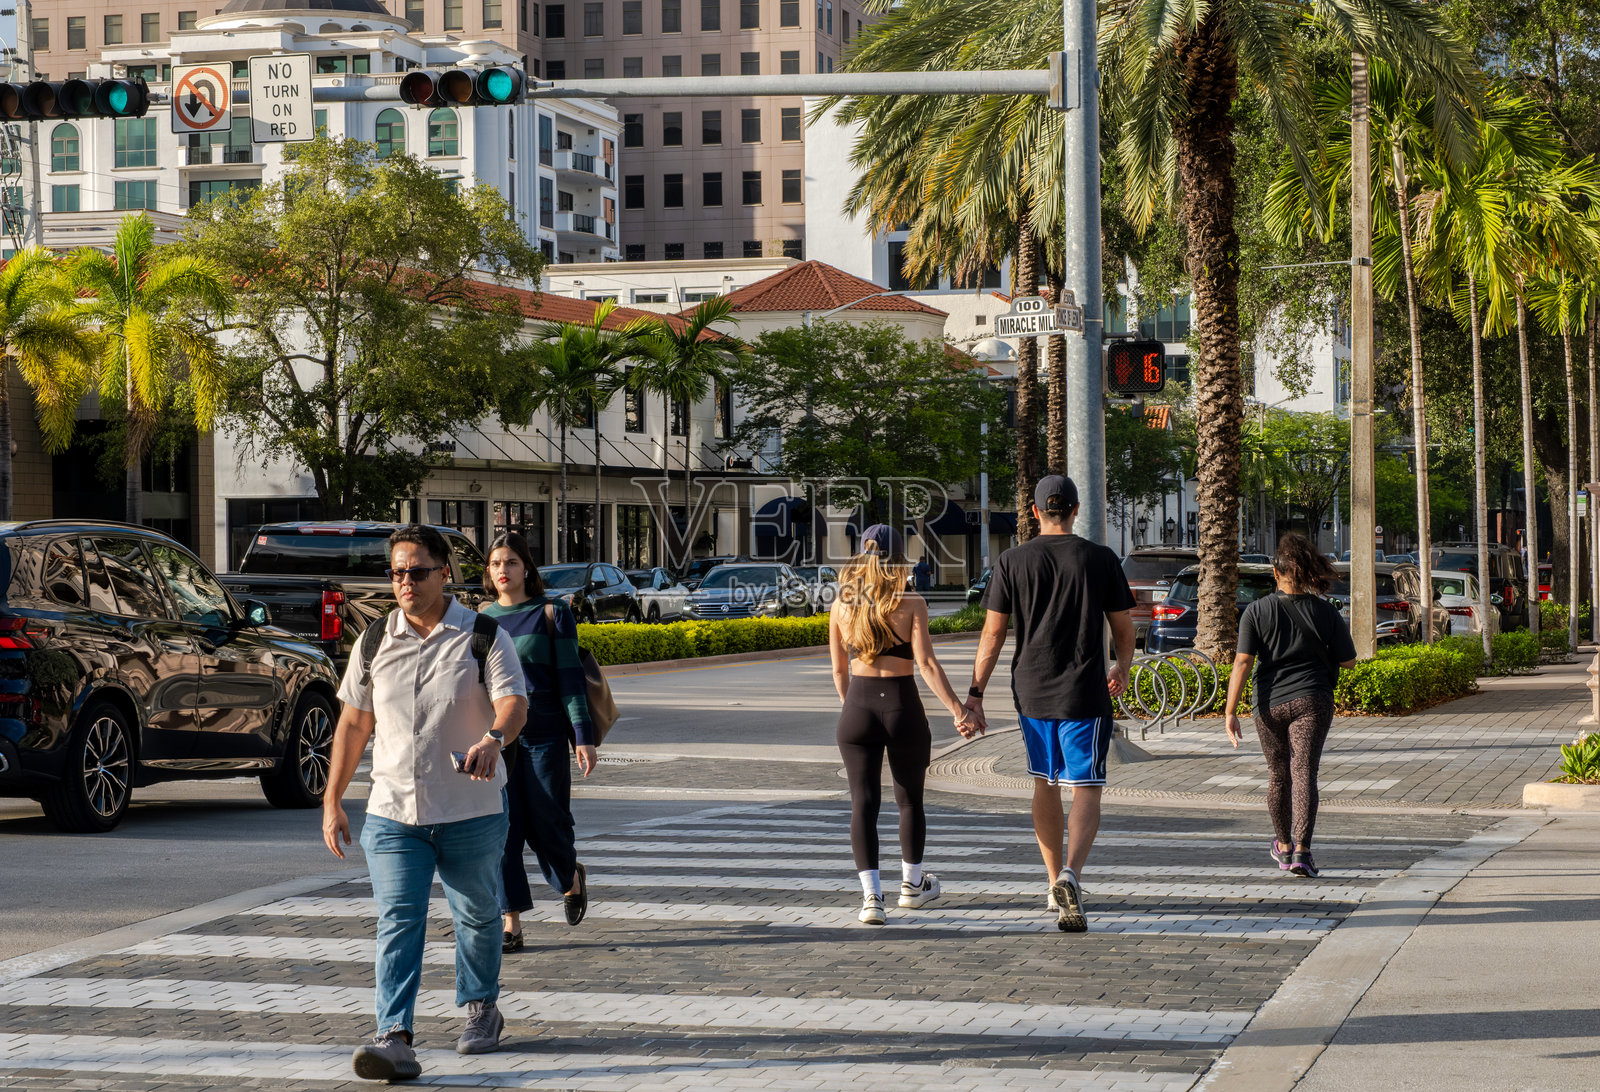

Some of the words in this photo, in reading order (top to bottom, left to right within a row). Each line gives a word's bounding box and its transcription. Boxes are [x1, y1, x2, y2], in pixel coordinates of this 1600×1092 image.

[268, 63, 292, 80] NO
[263, 84, 299, 98] TURN
[272, 103, 292, 117] ON
[270, 122, 296, 136] RED
[1018, 300, 1041, 312] 100
[999, 316, 1036, 335] MIRACLE
